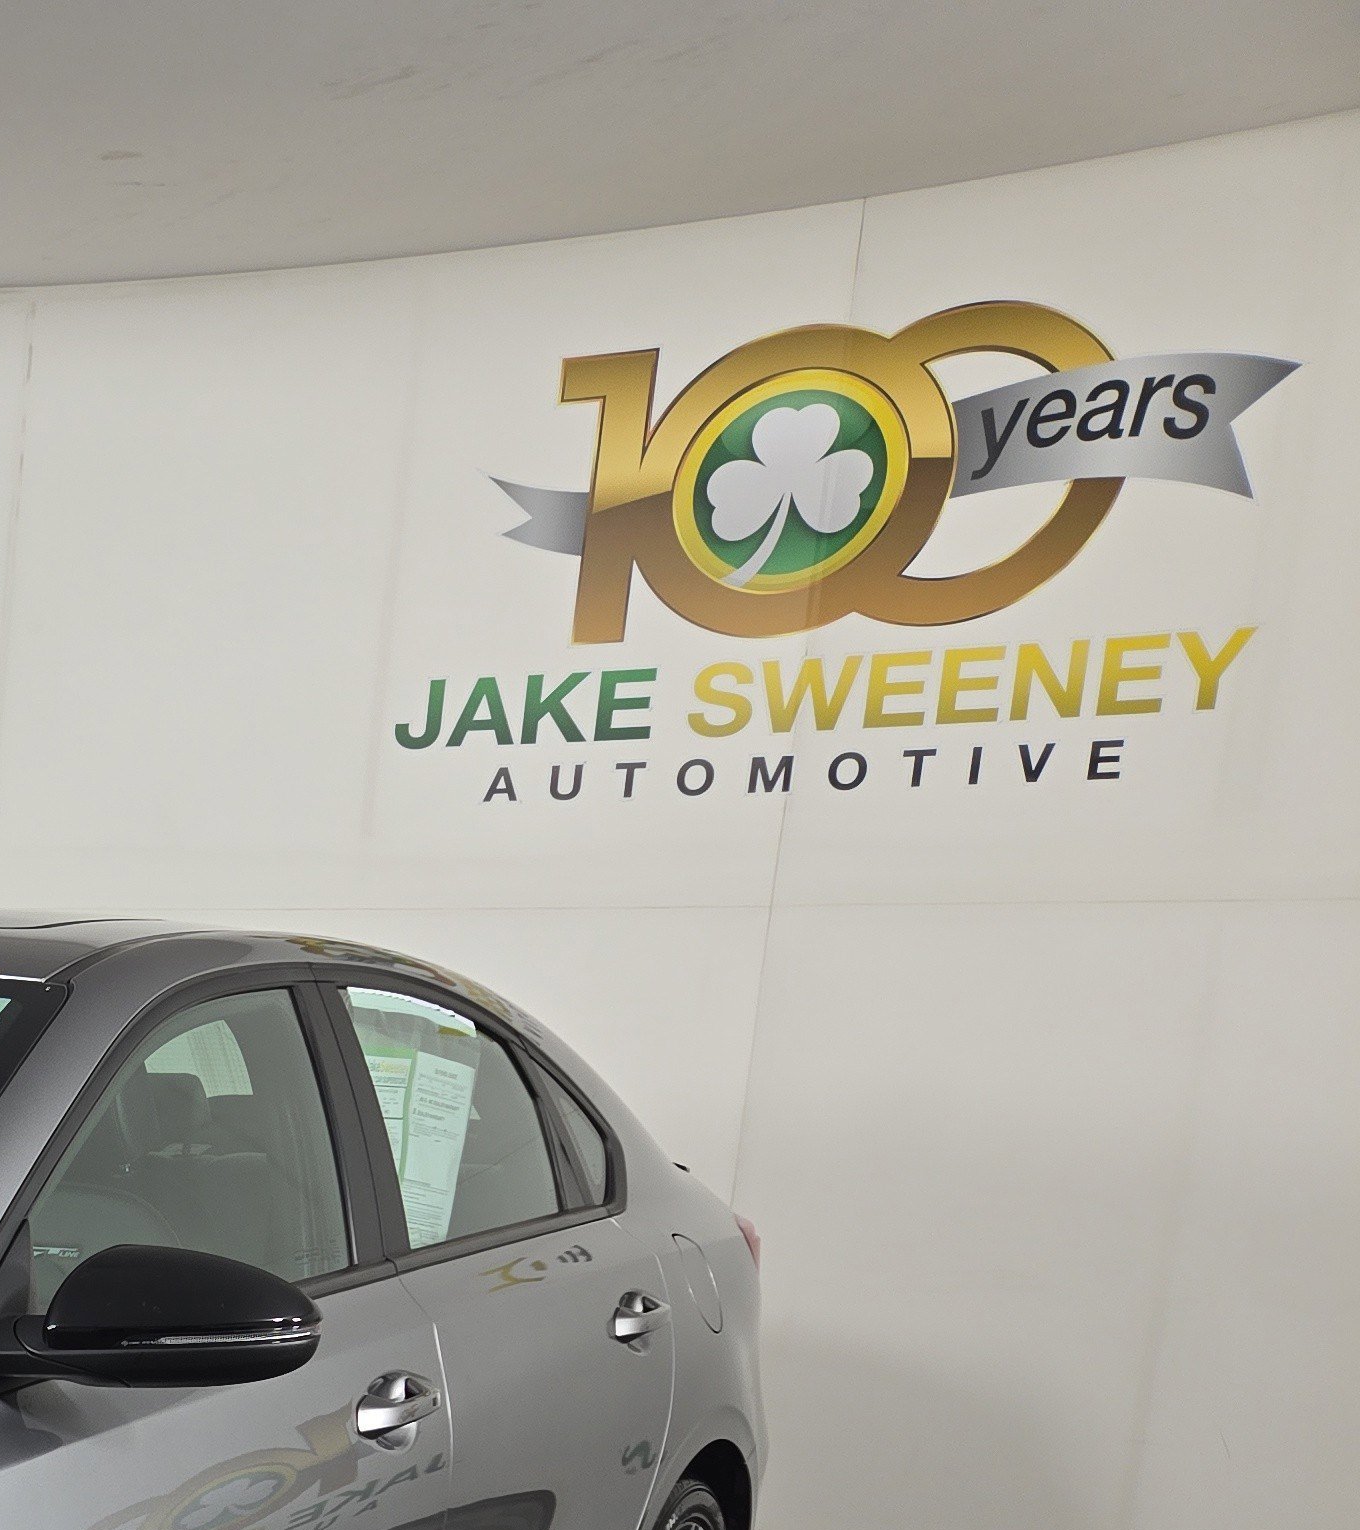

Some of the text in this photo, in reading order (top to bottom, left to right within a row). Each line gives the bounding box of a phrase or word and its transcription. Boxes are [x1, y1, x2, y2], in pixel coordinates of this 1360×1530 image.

[560, 300, 1216, 646] 100 years
[394, 626, 1258, 750] JAKE SWEENEY
[483, 739, 1126, 803] AUTOMOTIVE
